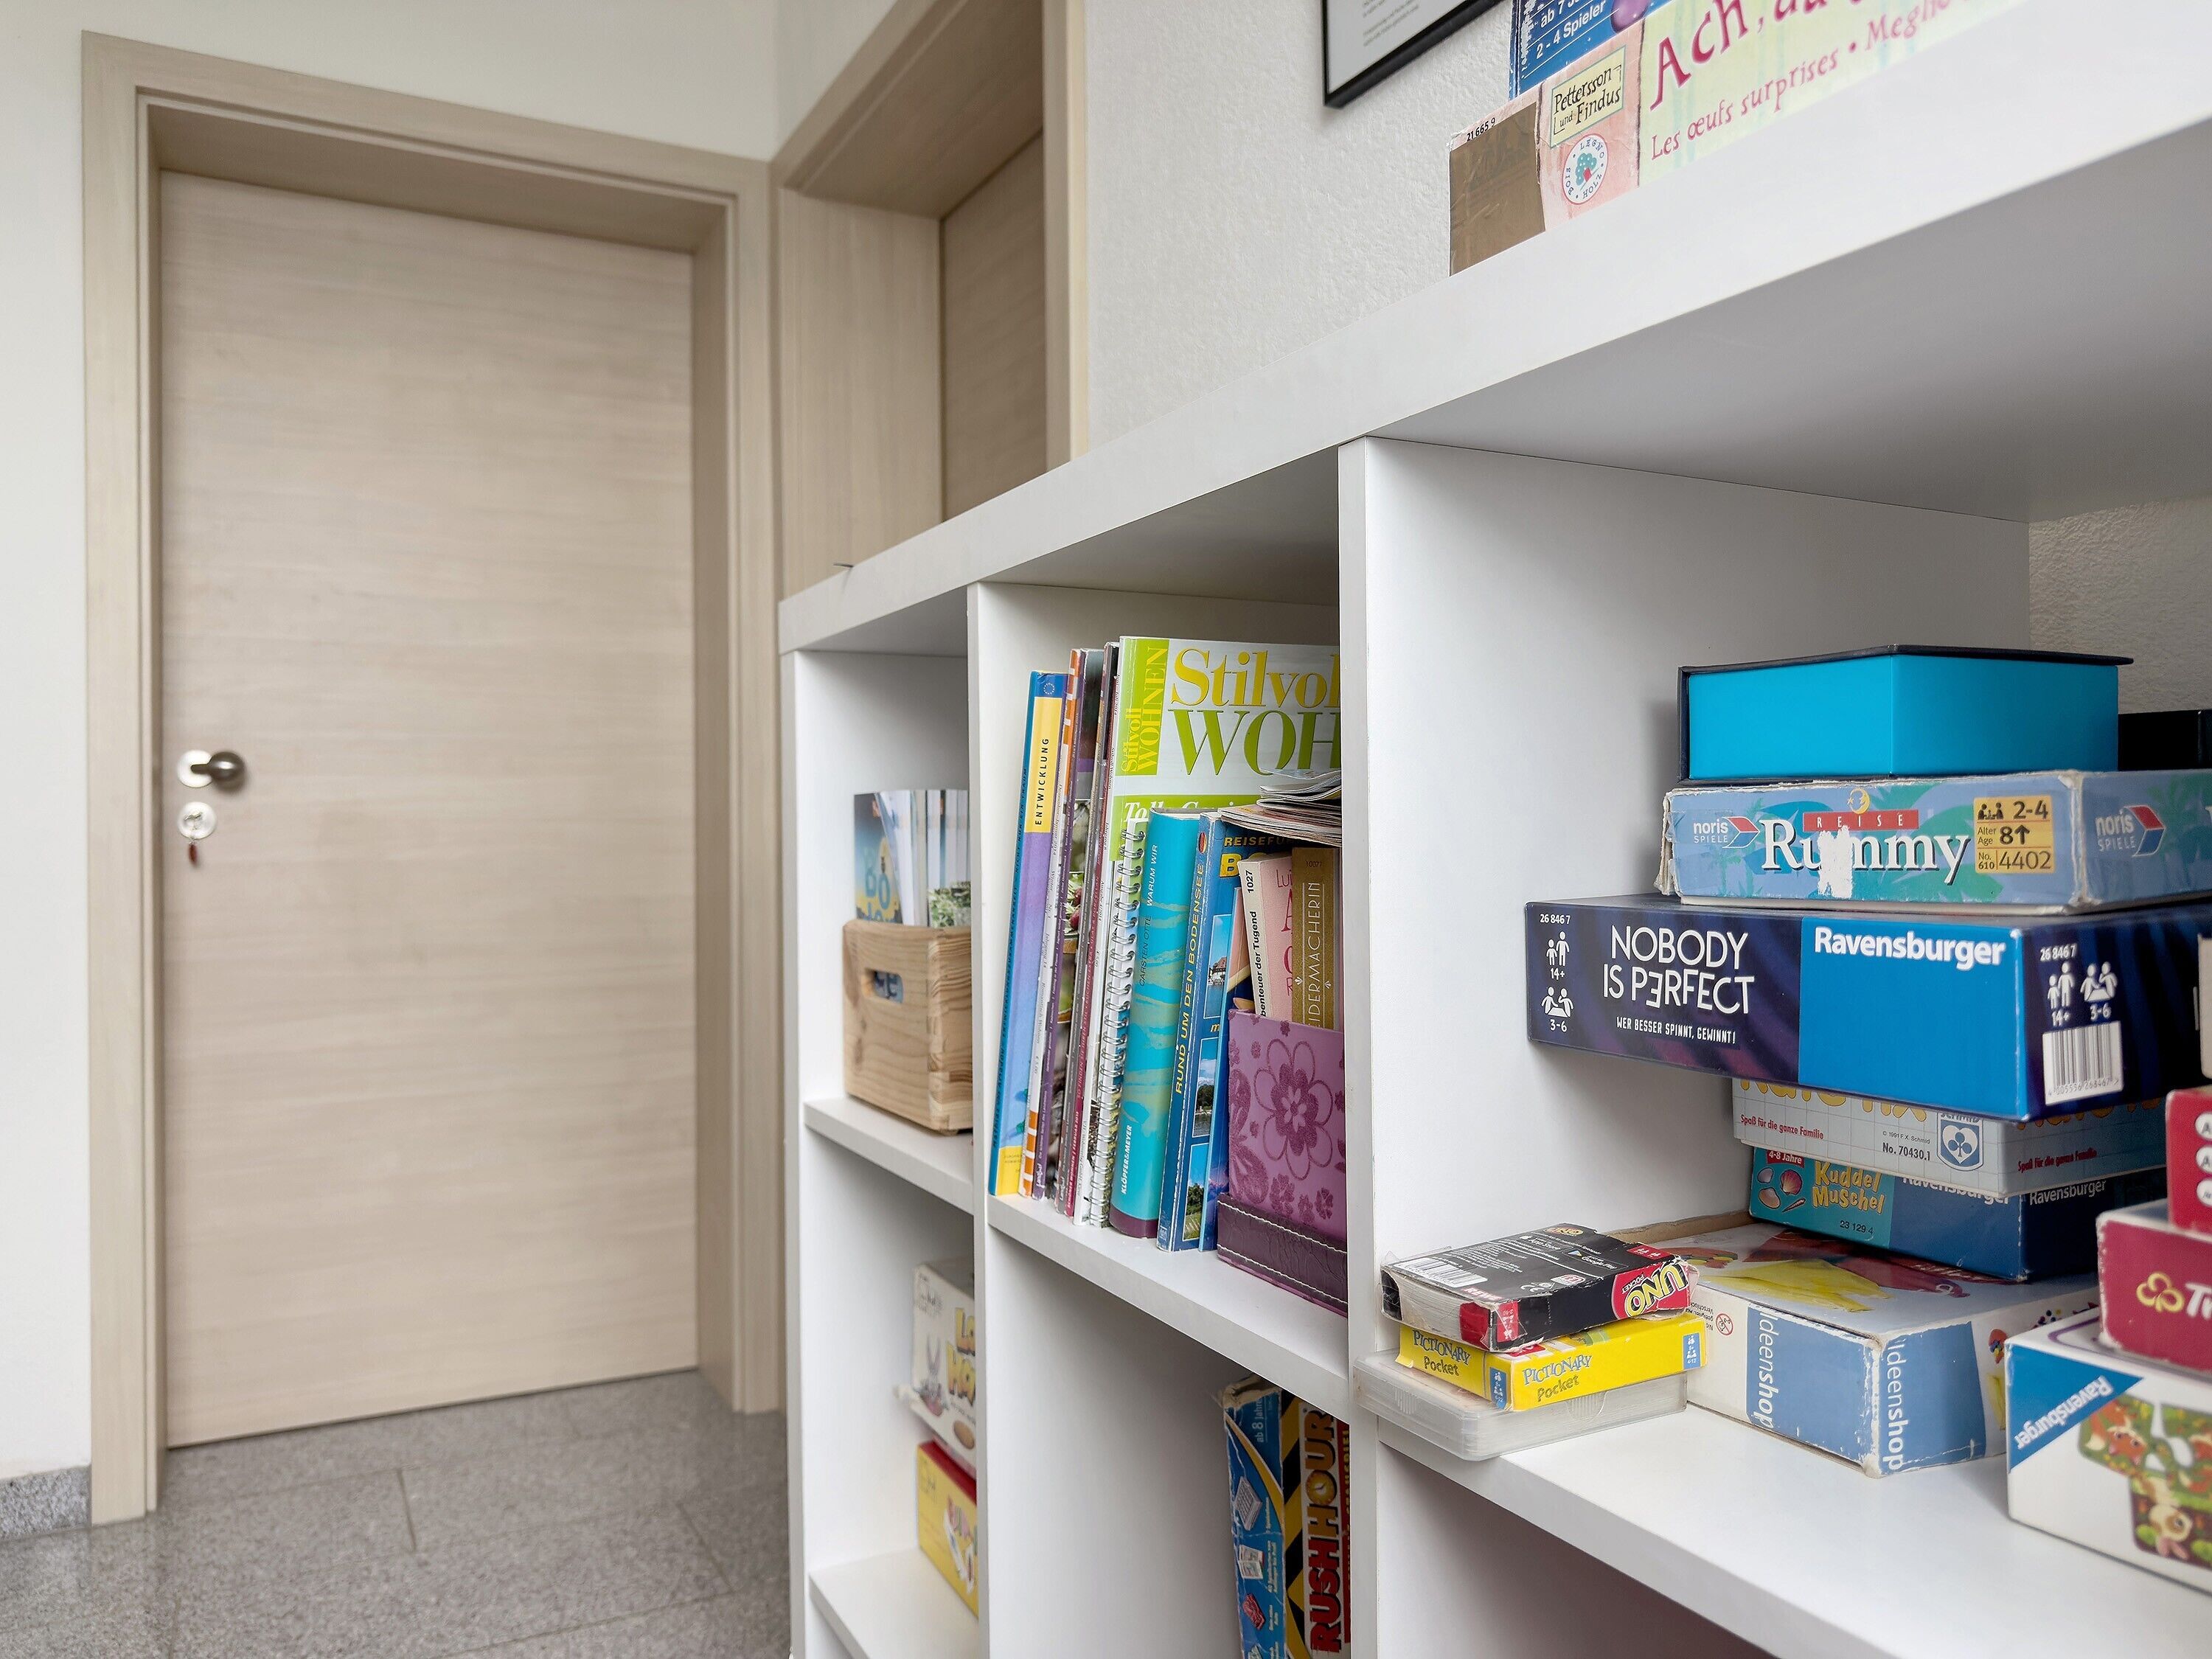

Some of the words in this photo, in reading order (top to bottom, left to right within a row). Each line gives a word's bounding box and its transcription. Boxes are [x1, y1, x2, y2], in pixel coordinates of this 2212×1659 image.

[1537, 43, 1543, 60] 2
[1553, 29, 1560, 44] 4
[1563, 0, 1607, 38] Spieler
[1541, 9, 1554, 28] ab
[1554, 68, 1612, 115] Pettersson
[1652, 129, 1680, 161] Les
[1741, 46, 1840, 114] surprises
[1560, 111, 1573, 127] und
[1576, 87, 1621, 125] Findus
[1467, 131, 1473, 142] 21
[1475, 121, 1489, 137] 665
[1491, 118, 1495, 127] 9
[1579, 137, 1605, 159] LEGNO
[1583, 174, 1602, 199] HOLZ
[1137, 647, 1169, 772] WOHNEN
[1121, 708, 1142, 773] Stilvoll
[1035, 738, 1050, 826] ENTWICKLUNG
[2013, 801, 2048, 820] 2-4
[1693, 818, 1728, 834] noris
[1978, 826, 1997, 836] Alter
[2096, 815, 2135, 835] noris
[1694, 835, 1728, 844] SPIELE
[1978, 836, 1994, 846] Age
[2098, 837, 2137, 852] SPIELE
[1978, 852, 1992, 861] No.
[1978, 861, 1995, 870] 610
[1998, 851, 2052, 870] 4402
[1147, 869, 1157, 906] WARUM
[1188, 863, 1204, 964] BODENSEE
[1250, 911, 1261, 950] Tugend
[1611, 925, 1749, 970] NOBODY
[1814, 926, 2006, 972] Ravensburger
[1139, 942, 1148, 987] CARSTEN
[1550, 967, 1565, 981] 14+
[1184, 970, 1193, 1007] DEN
[1604, 963, 1624, 999] IS
[1256, 972, 1267, 1017] benteuer
[2051, 1009, 2070, 1027] 14+
[2090, 1003, 2112, 1021] 3-6
[1180, 1013, 1189, 1039] UM
[1550, 1019, 1568, 1032] 3-6
[1616, 1016, 1632, 1029] WER
[1634, 1018, 1662, 1034] BESSER
[1665, 1022, 1694, 1040] SPINNT,
[1697, 1027, 1736, 1044] GEWINNT!
[1175, 1043, 1187, 1094] RUND
[1740, 1113, 1756, 1126] Spaß
[1758, 1117, 1767, 1127] für
[1767, 1119, 1778, 1130] die
[1779, 1124, 1798, 1135] ganze
[1800, 1127, 1824, 1140] Familie
[1910, 1135, 1930, 1144] Schmid
[1120, 1124, 1133, 1195] KLÖPFER&MEYER
[1769, 1150, 1781, 1160] 4-8
[1781, 1153, 1802, 1165] Jahre
[1882, 1143, 1896, 1155] No.
[1899, 1145, 1930, 1161] 70430.1
[2034, 1155, 2044, 1169] für
[2045, 1155, 2055, 1166] die
[1815, 1161, 1882, 1192] Kuddel
[2029, 1180, 2107, 1206] Ravensburger
[1840, 1220, 1849, 1229] 23
[1852, 1222, 1866, 1233] 129
[1868, 1226, 1874, 1234] 4
[1622, 1273, 1646, 1295] POCKET
[1624, 1261, 1687, 1318] UNO
[1413, 1329, 1470, 1366] PICTIONARY
[1423, 1355, 1459, 1377] Pocket
[1522, 1355, 1593, 1386] PICTIONARY
[1758, 1310, 1779, 1429] Ideenshop
[1537, 1374, 1579, 1402] Pocket
[1255, 1399, 1264, 1420] Jahre
[1882, 1337, 1910, 1472] Ideenshop
[2015, 1376, 2114, 1451] Ravensburger
[1252, 1422, 1264, 1432] 8
[1256, 1432, 1264, 1442] ab
